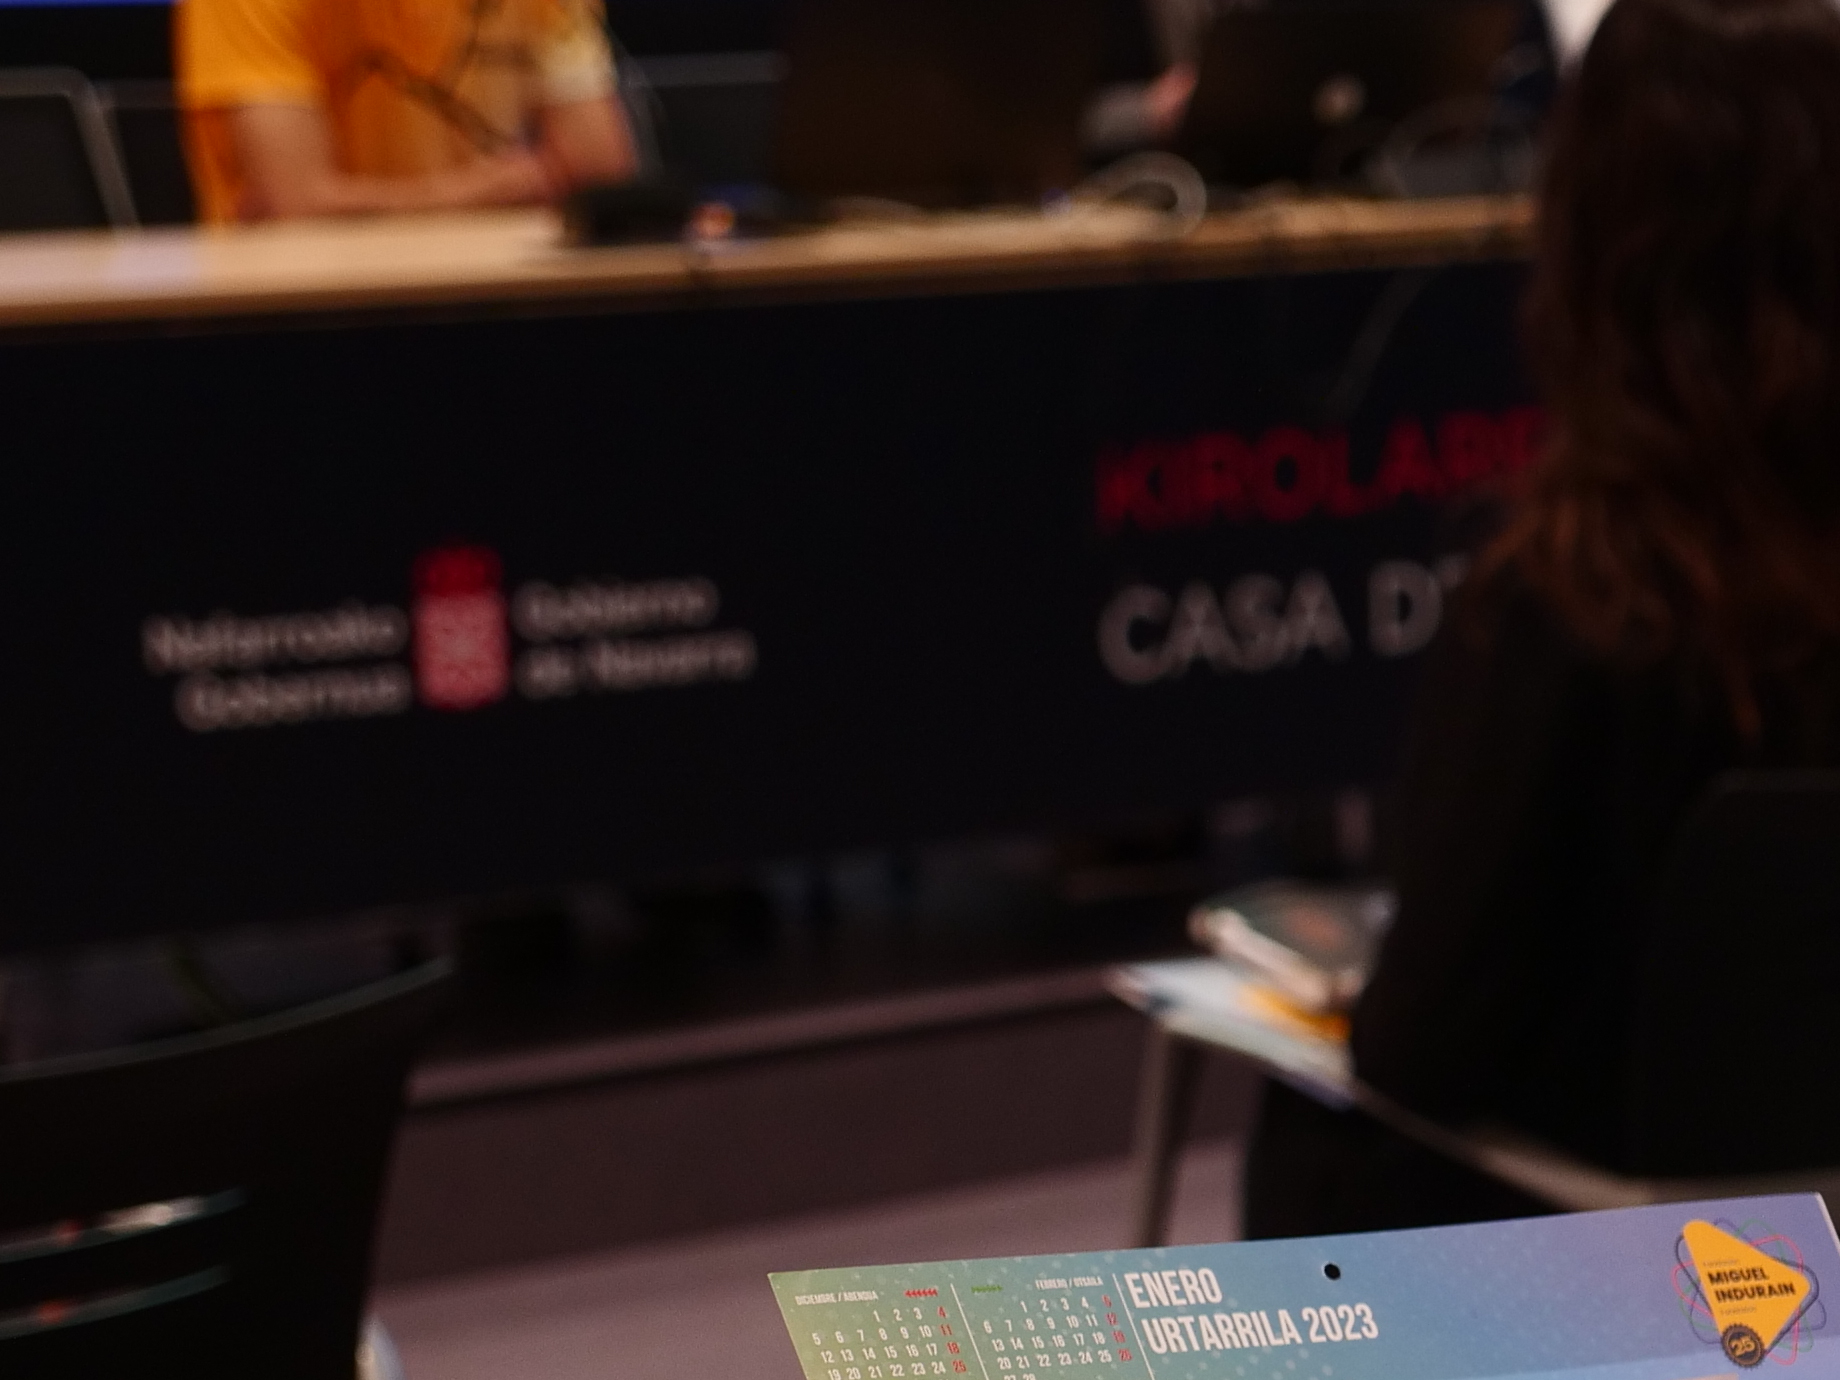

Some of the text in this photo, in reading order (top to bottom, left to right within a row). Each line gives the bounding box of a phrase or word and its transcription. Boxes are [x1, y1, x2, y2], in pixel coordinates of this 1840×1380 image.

[1099, 570, 1351, 682] CASA
[1707, 1267, 1769, 1284] MIGUEL
[1123, 1267, 1223, 1308] ENERO
[1714, 1282, 1796, 1303] INDURAIN
[1141, 1303, 1379, 1354] URTARRILA 2023
[821, 1346, 897, 1363] 12 13 14 15
[997, 1354, 1051, 1370] 20 21 22
[846, 1367, 861, 1380] 20
[868, 1365, 882, 1378] 21
[890, 1364, 905, 1377] 22
